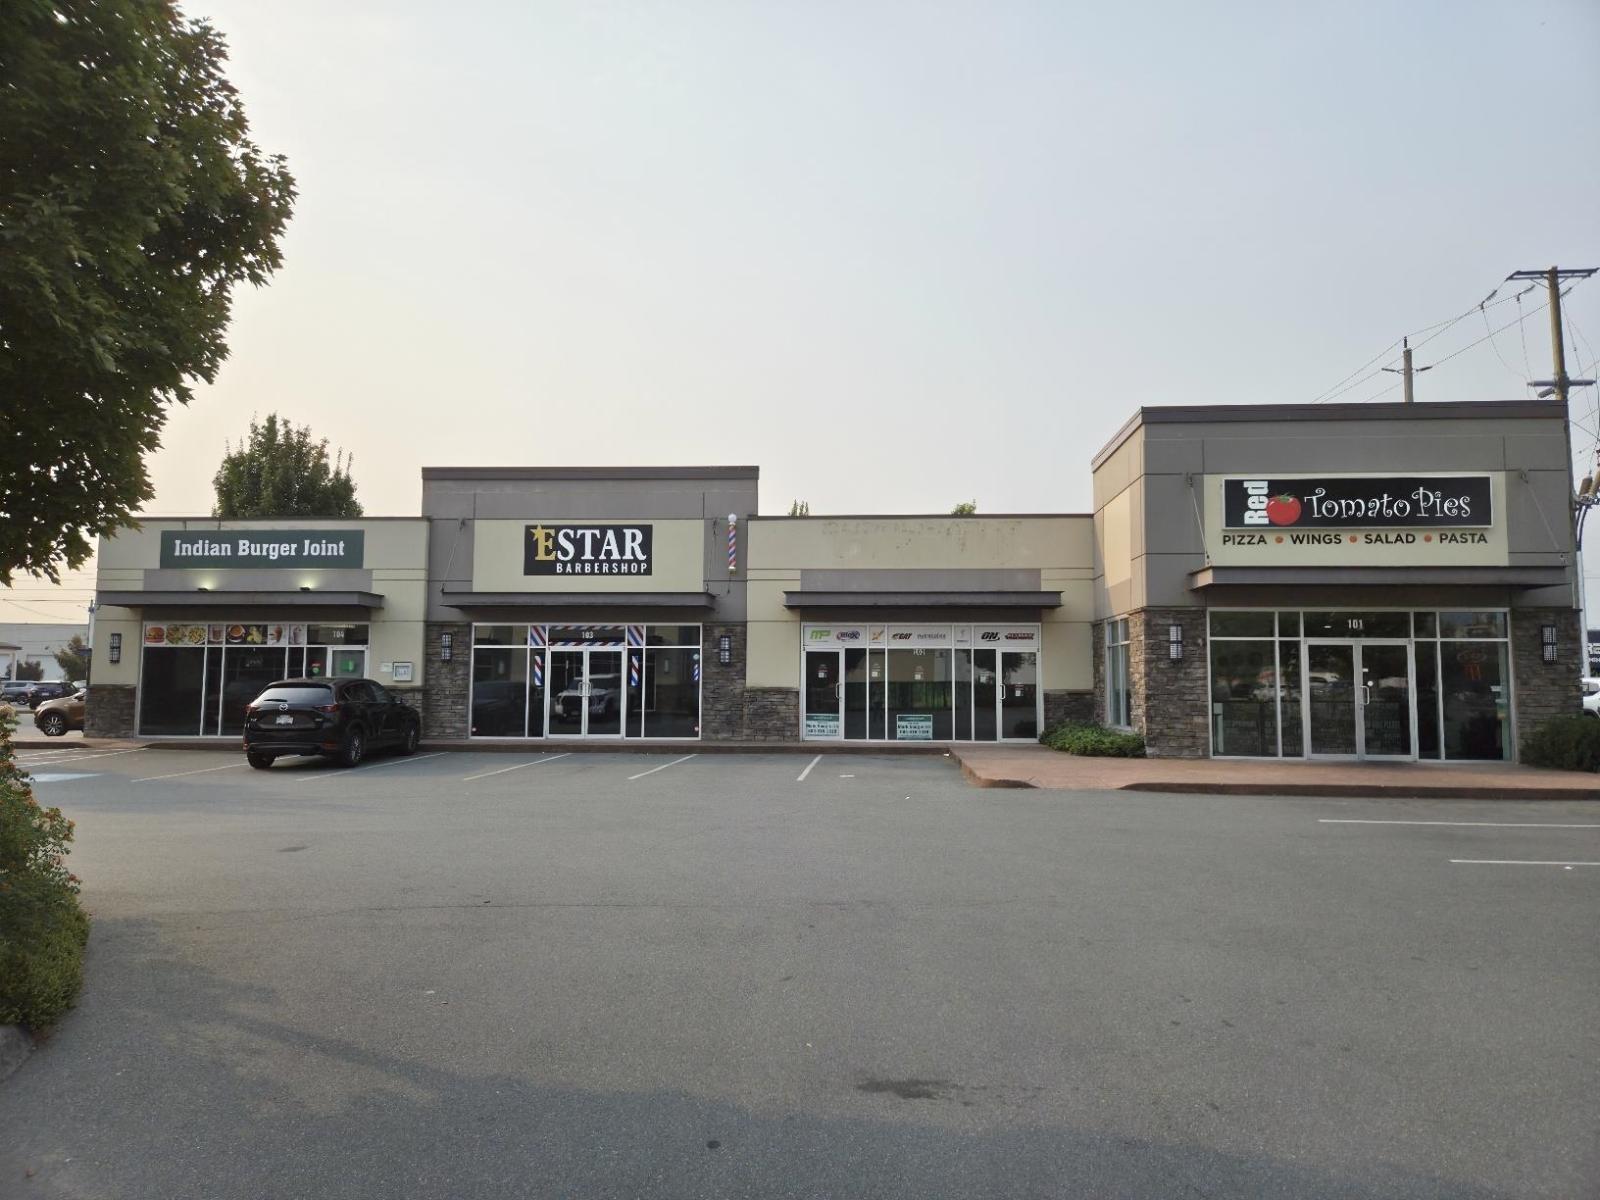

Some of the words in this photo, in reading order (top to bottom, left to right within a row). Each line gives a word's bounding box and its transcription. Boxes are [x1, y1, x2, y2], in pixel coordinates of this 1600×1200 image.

[1243, 481, 1269, 525] Red
[1304, 487, 1411, 518] Tomato
[1411, 486, 1471, 518] Pies
[534, 527, 647, 561] ESTAR
[1222, 534, 1267, 545] PIZZA
[1290, 533, 1342, 545] WINGS
[1364, 533, 1416, 544] SALAD
[1439, 533, 1488, 544] PASTA
[174, 539, 232, 556] Indian
[237, 539, 298, 560] Burger
[302, 539, 345, 556] Joint
[556, 562, 648, 574] BARBERSHOP
[1347, 619, 1363, 630] 101
[582, 631, 594, 639] 103
